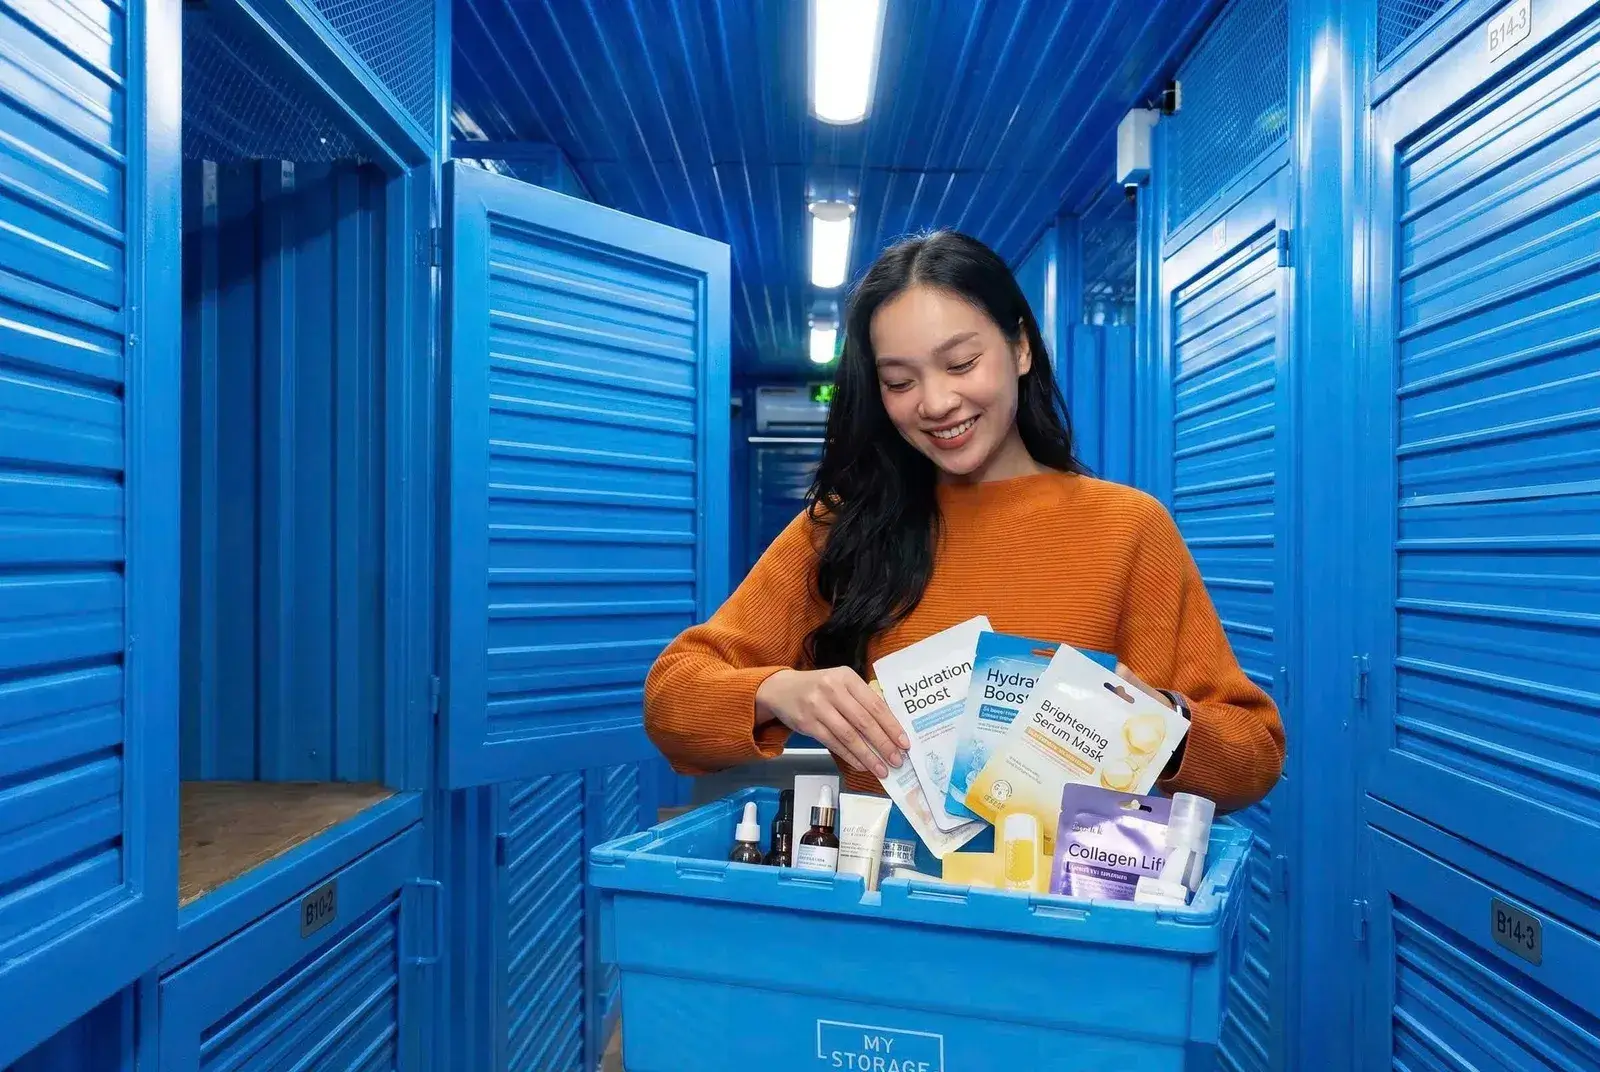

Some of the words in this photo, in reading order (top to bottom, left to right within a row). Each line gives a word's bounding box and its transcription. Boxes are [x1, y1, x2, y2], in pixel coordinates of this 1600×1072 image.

[1490, 7, 1527, 51] B14-3
[898, 661, 972, 698] Hydration
[987, 668, 1039, 688] Hydra
[904, 687, 951, 714] Boost
[984, 685, 1029, 704] Boos
[1033, 712, 1071, 741] Serum
[1071, 736, 1104, 762] Mask
[1041, 699, 1108, 749] Brightening
[1069, 843, 1137, 867] Collagen
[306, 889, 333, 926] B10-2
[1497, 909, 1534, 950] B14-3
[863, 1034, 894, 1053] MY
[831, 1050, 930, 1072] STORAGE
